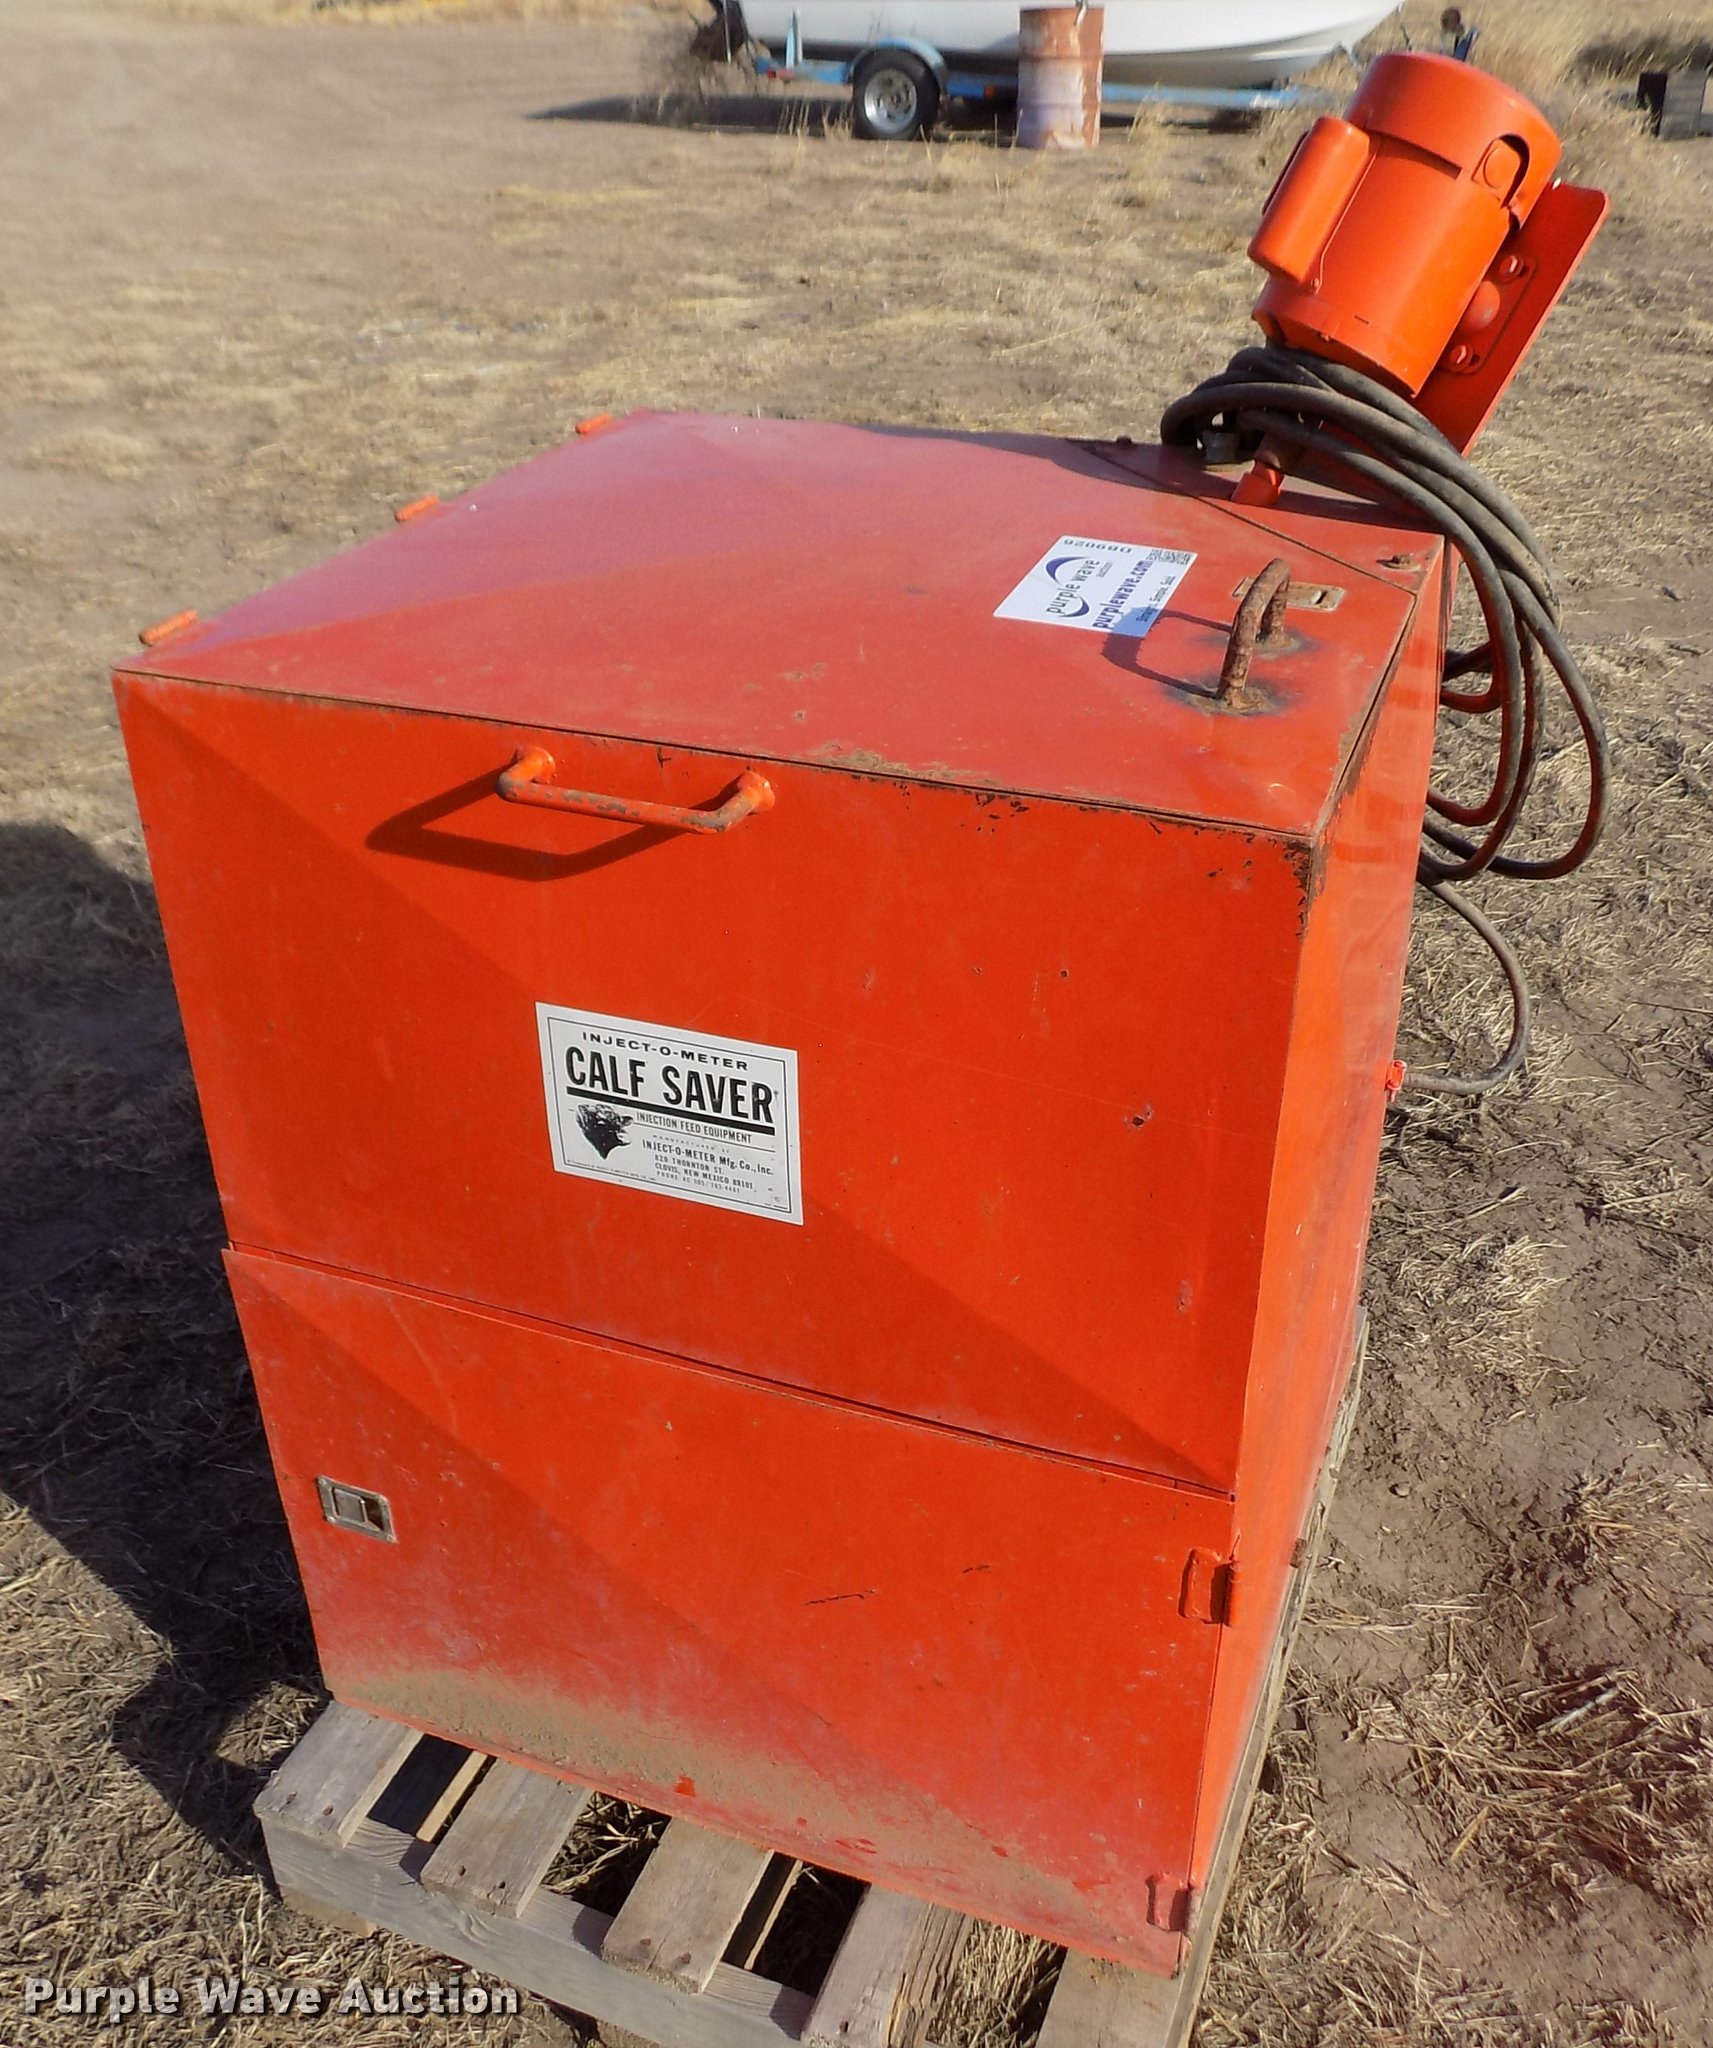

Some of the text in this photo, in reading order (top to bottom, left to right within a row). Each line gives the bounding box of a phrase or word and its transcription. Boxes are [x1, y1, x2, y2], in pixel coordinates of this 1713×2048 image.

[1046, 559, 1101, 615] purple wave
[1092, 560, 1154, 630] purplewave.com
[582, 1031, 748, 1071] INJECT-O-METER
[565, 1046, 774, 1124] CALF SAVER
[636, 1111, 752, 1144] INJECTION FEED EQUIPMENT
[642, 1140, 716, 1163] INJECT-O-METER
[719, 1155, 738, 1170] Mfg.
[757, 1164, 774, 1176] Inc.
[671, 1157, 710, 1172] THORNTON
[683, 1168, 699, 1178] NEW
[702, 1171, 730, 1184] MEXICO
